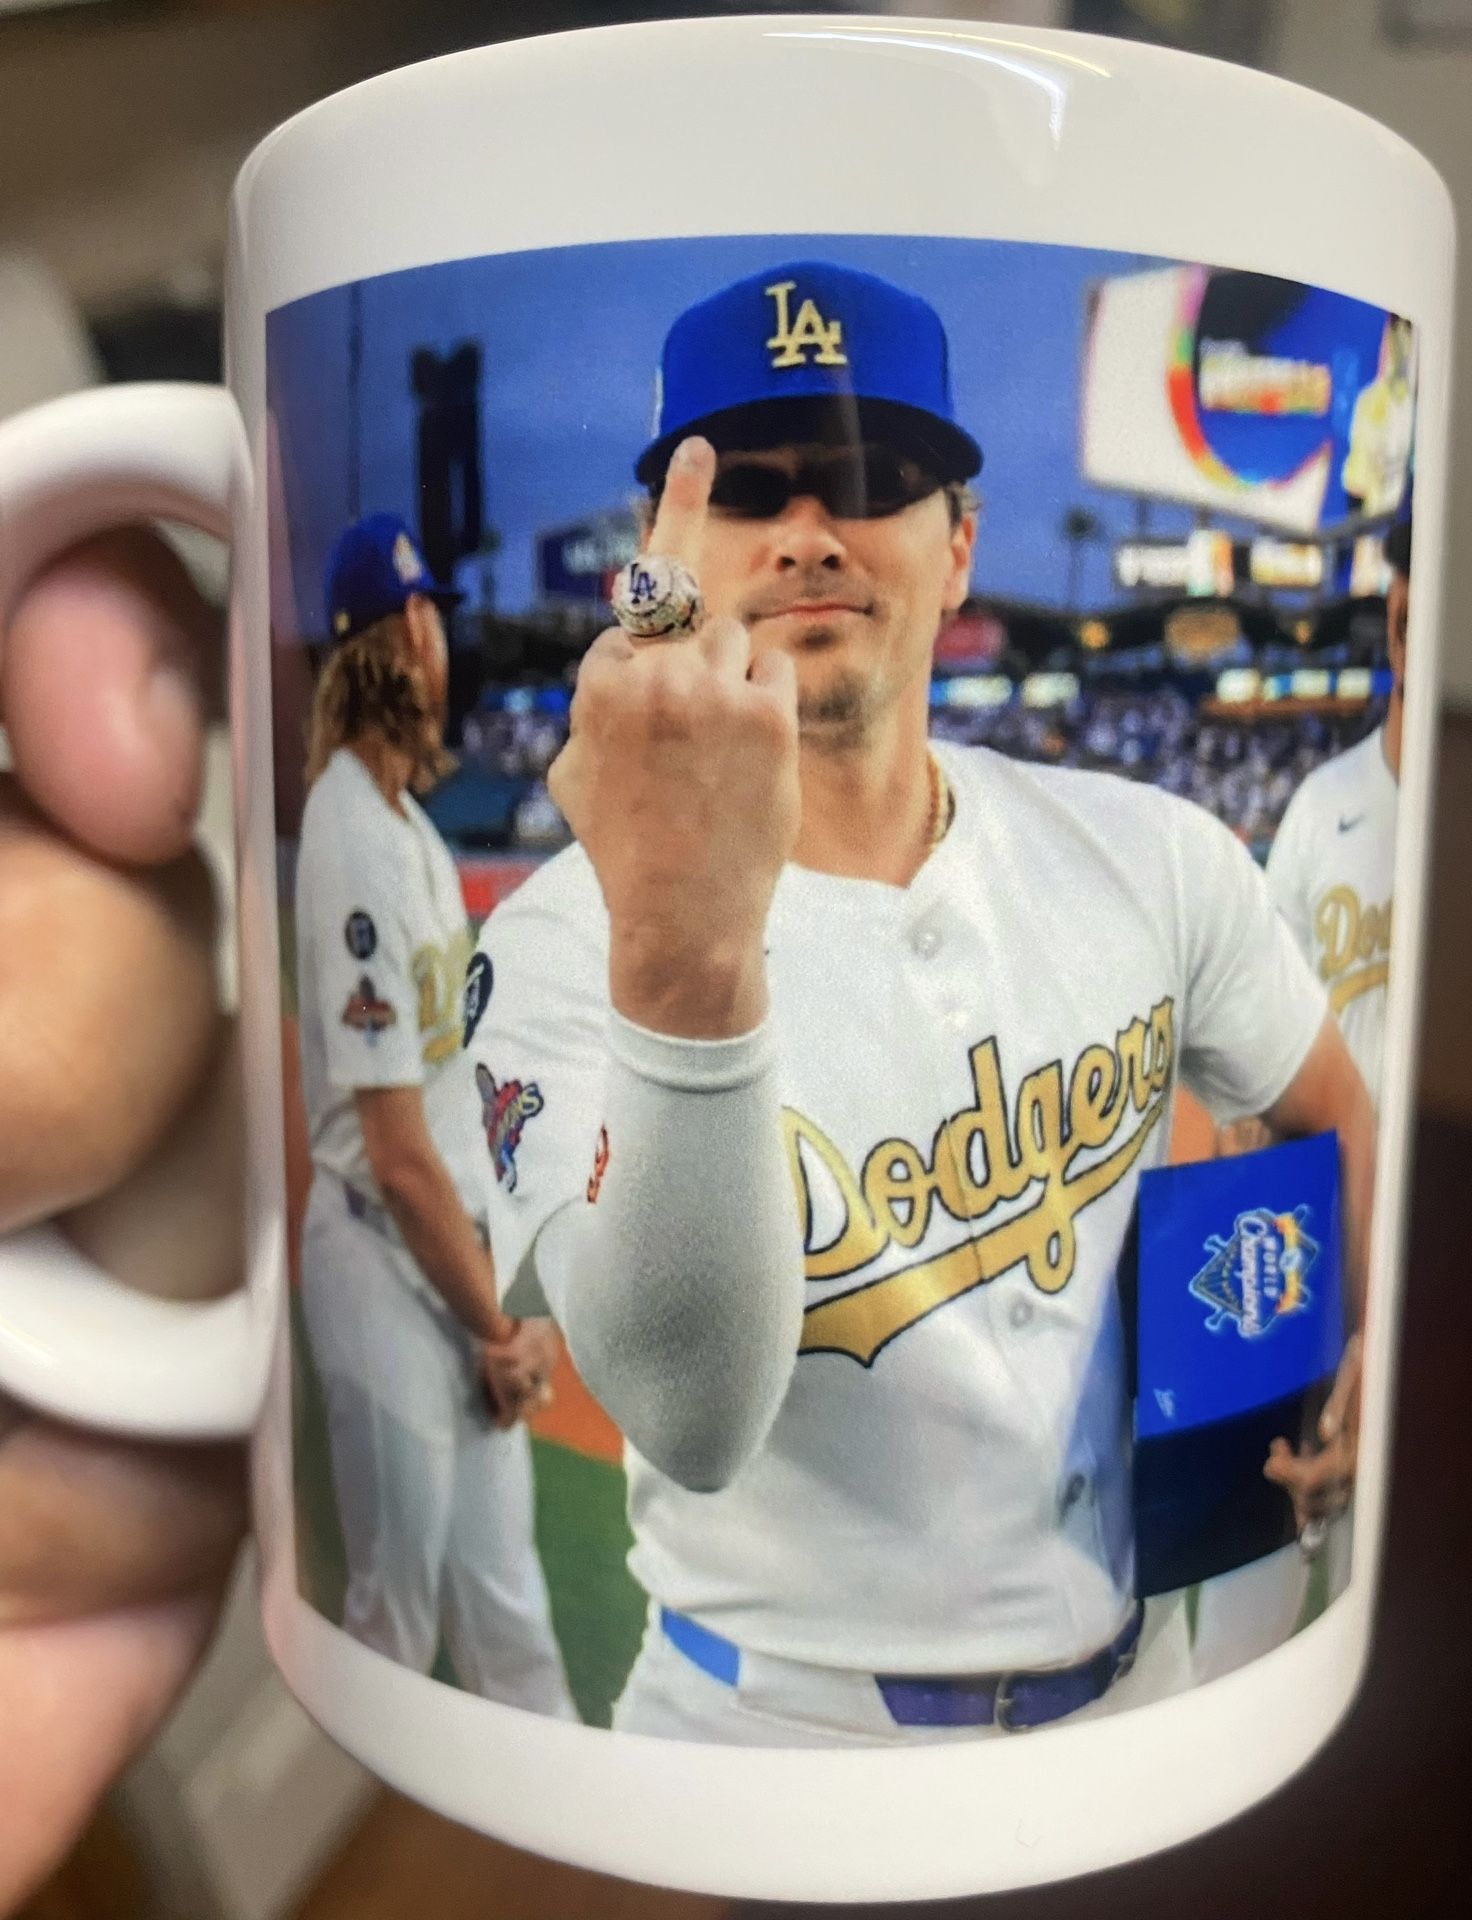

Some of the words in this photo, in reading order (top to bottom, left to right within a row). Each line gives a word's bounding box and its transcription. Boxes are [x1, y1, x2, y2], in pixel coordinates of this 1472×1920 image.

[765, 281, 848, 368] LA
[628, 561, 657, 605] LA
[783, 996, 1174, 1294] Dodgers
